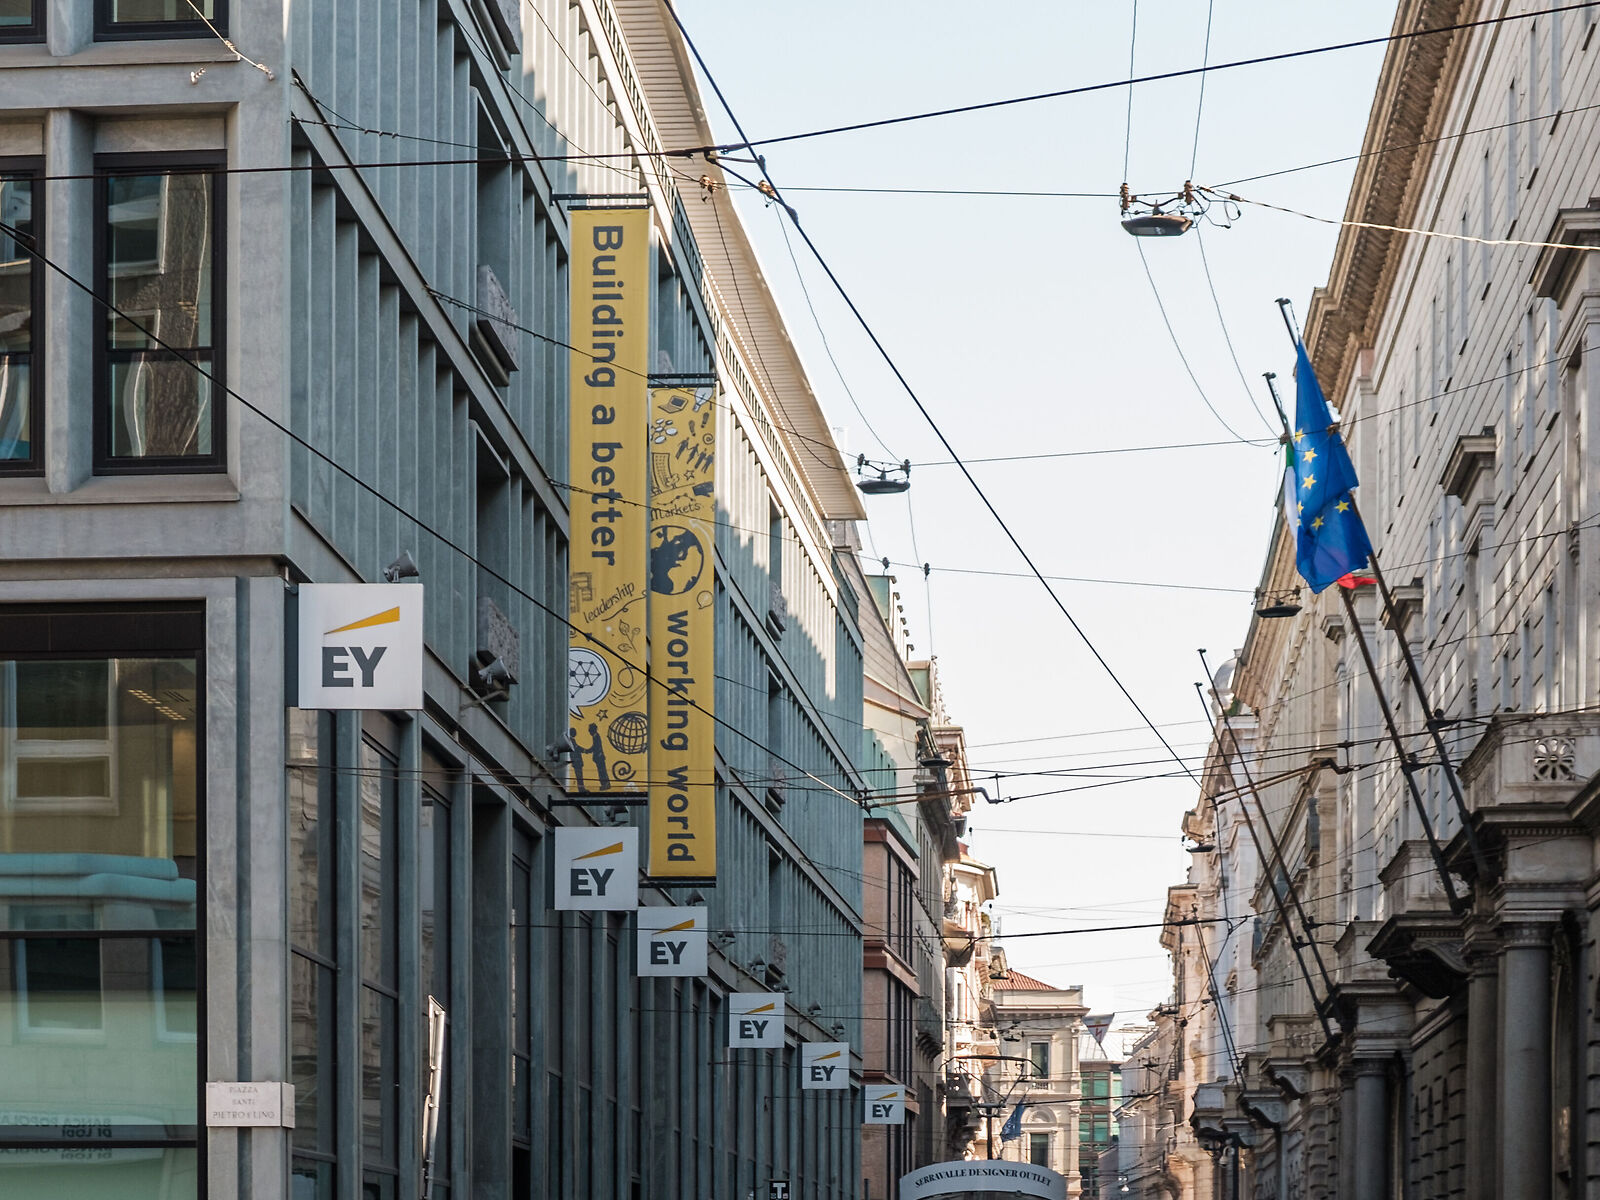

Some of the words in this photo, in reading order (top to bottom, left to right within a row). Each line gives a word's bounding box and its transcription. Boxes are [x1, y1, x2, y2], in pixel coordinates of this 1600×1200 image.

[584, 225, 624, 388] Building
[591, 406, 616, 425] a
[591, 442, 623, 566] better
[650, 502, 701, 521] Markets
[583, 582, 635, 624] leadership
[322, 646, 388, 688] EY
[660, 610, 696, 751] working
[667, 765, 696, 862] world
[570, 868, 614, 896] EY
[651, 941, 687, 964] EY
[739, 1020, 768, 1039] EY
[810, 1065, 836, 1081] EY
[872, 1104, 893, 1118] EY
[914, 1169, 967, 1188] SERRAVALLE
[968, 1168, 1018, 1177] DESIGNER
[1019, 1170, 1052, 1187] OUTLET
[772, 1182, 786, 1199] T
